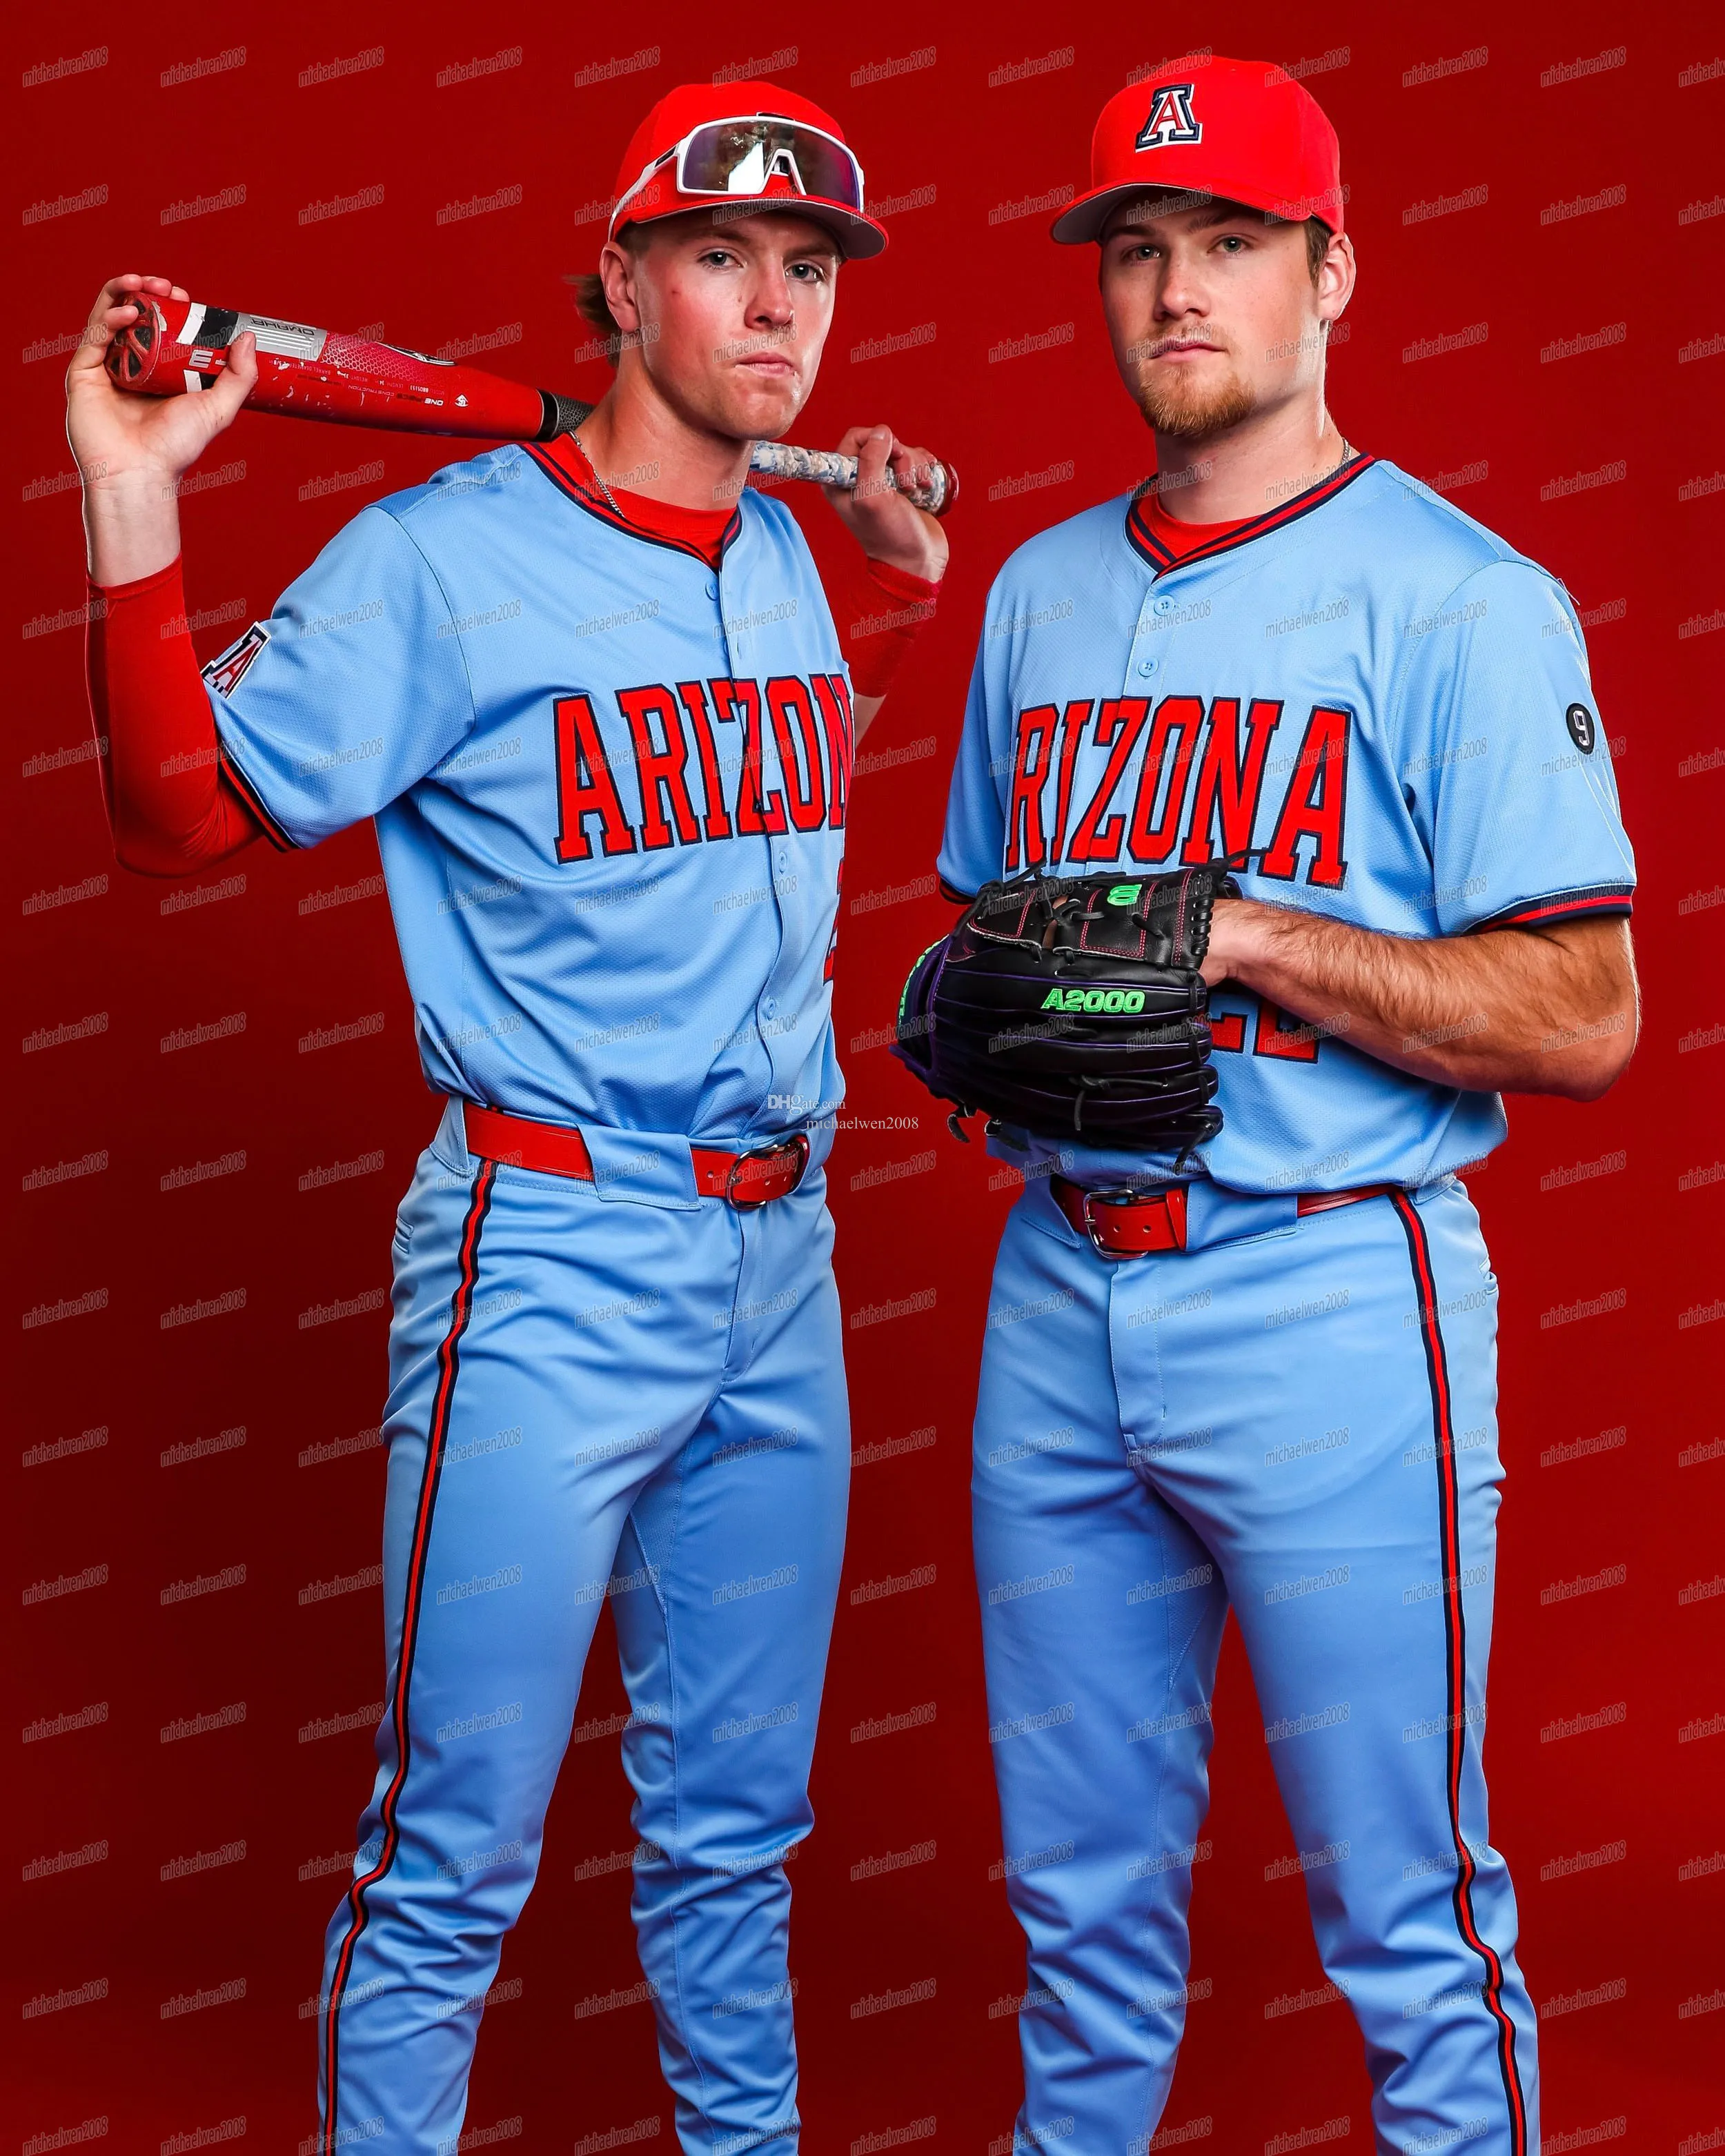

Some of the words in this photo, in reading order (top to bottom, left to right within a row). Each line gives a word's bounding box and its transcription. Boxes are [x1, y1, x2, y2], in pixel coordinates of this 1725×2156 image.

[1135, 83, 1203, 152] A
[253, 319, 315, 336] OMAHA
[349, 385, 395, 397] CONSTRUCTION
[424, 397, 444, 406] ONE
[200, 621, 271, 700] A
[1573, 710, 1590, 746] 9
[1041, 989, 1145, 1013] A2000
